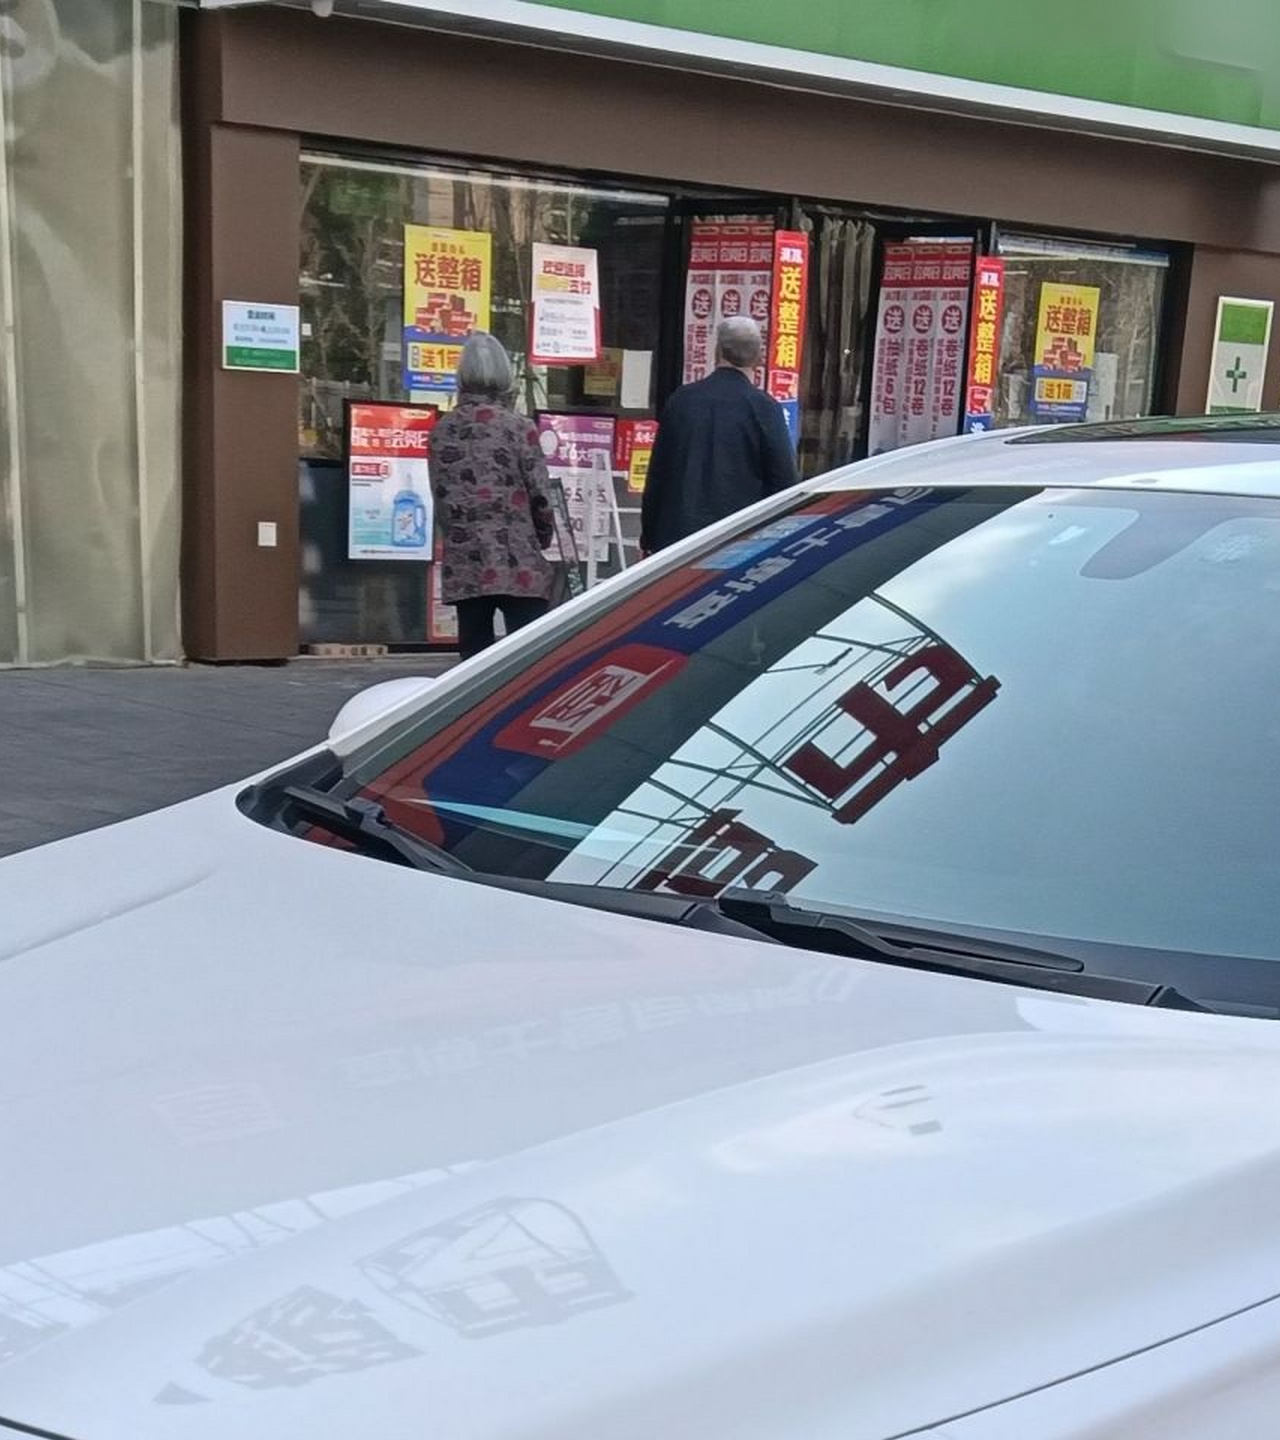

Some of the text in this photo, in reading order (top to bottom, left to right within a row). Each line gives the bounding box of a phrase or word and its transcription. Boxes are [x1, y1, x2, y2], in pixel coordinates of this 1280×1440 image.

[414, 253, 483, 292] 送整箱
[776, 266, 801, 368] 送整箱
[974, 290, 998, 385] 送整箱
[1044, 305, 1093, 336] 送整箱
